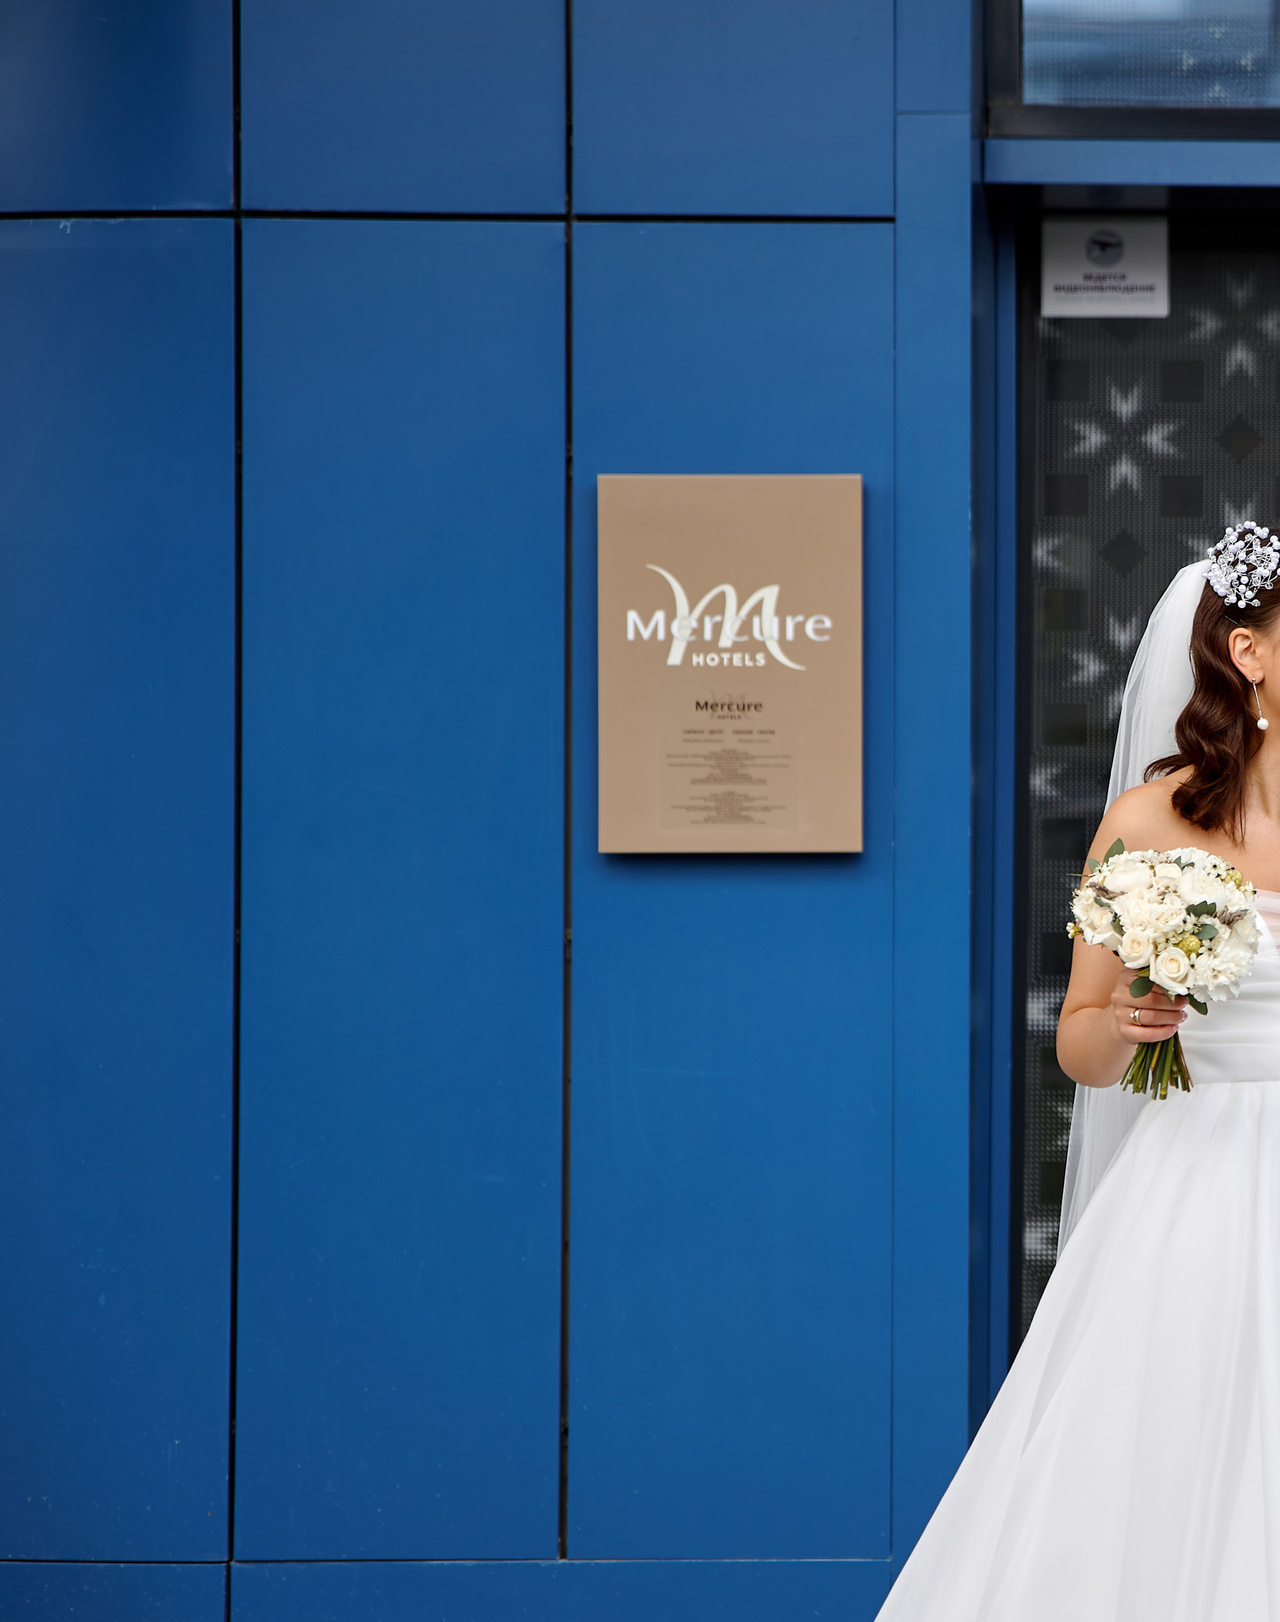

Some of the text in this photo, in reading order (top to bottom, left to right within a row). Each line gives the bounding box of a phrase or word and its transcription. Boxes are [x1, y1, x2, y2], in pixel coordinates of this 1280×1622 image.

[626, 609, 833, 642] Mercure
[692, 652, 766, 667] HOTELS
[695, 700, 763, 713] Mercure
